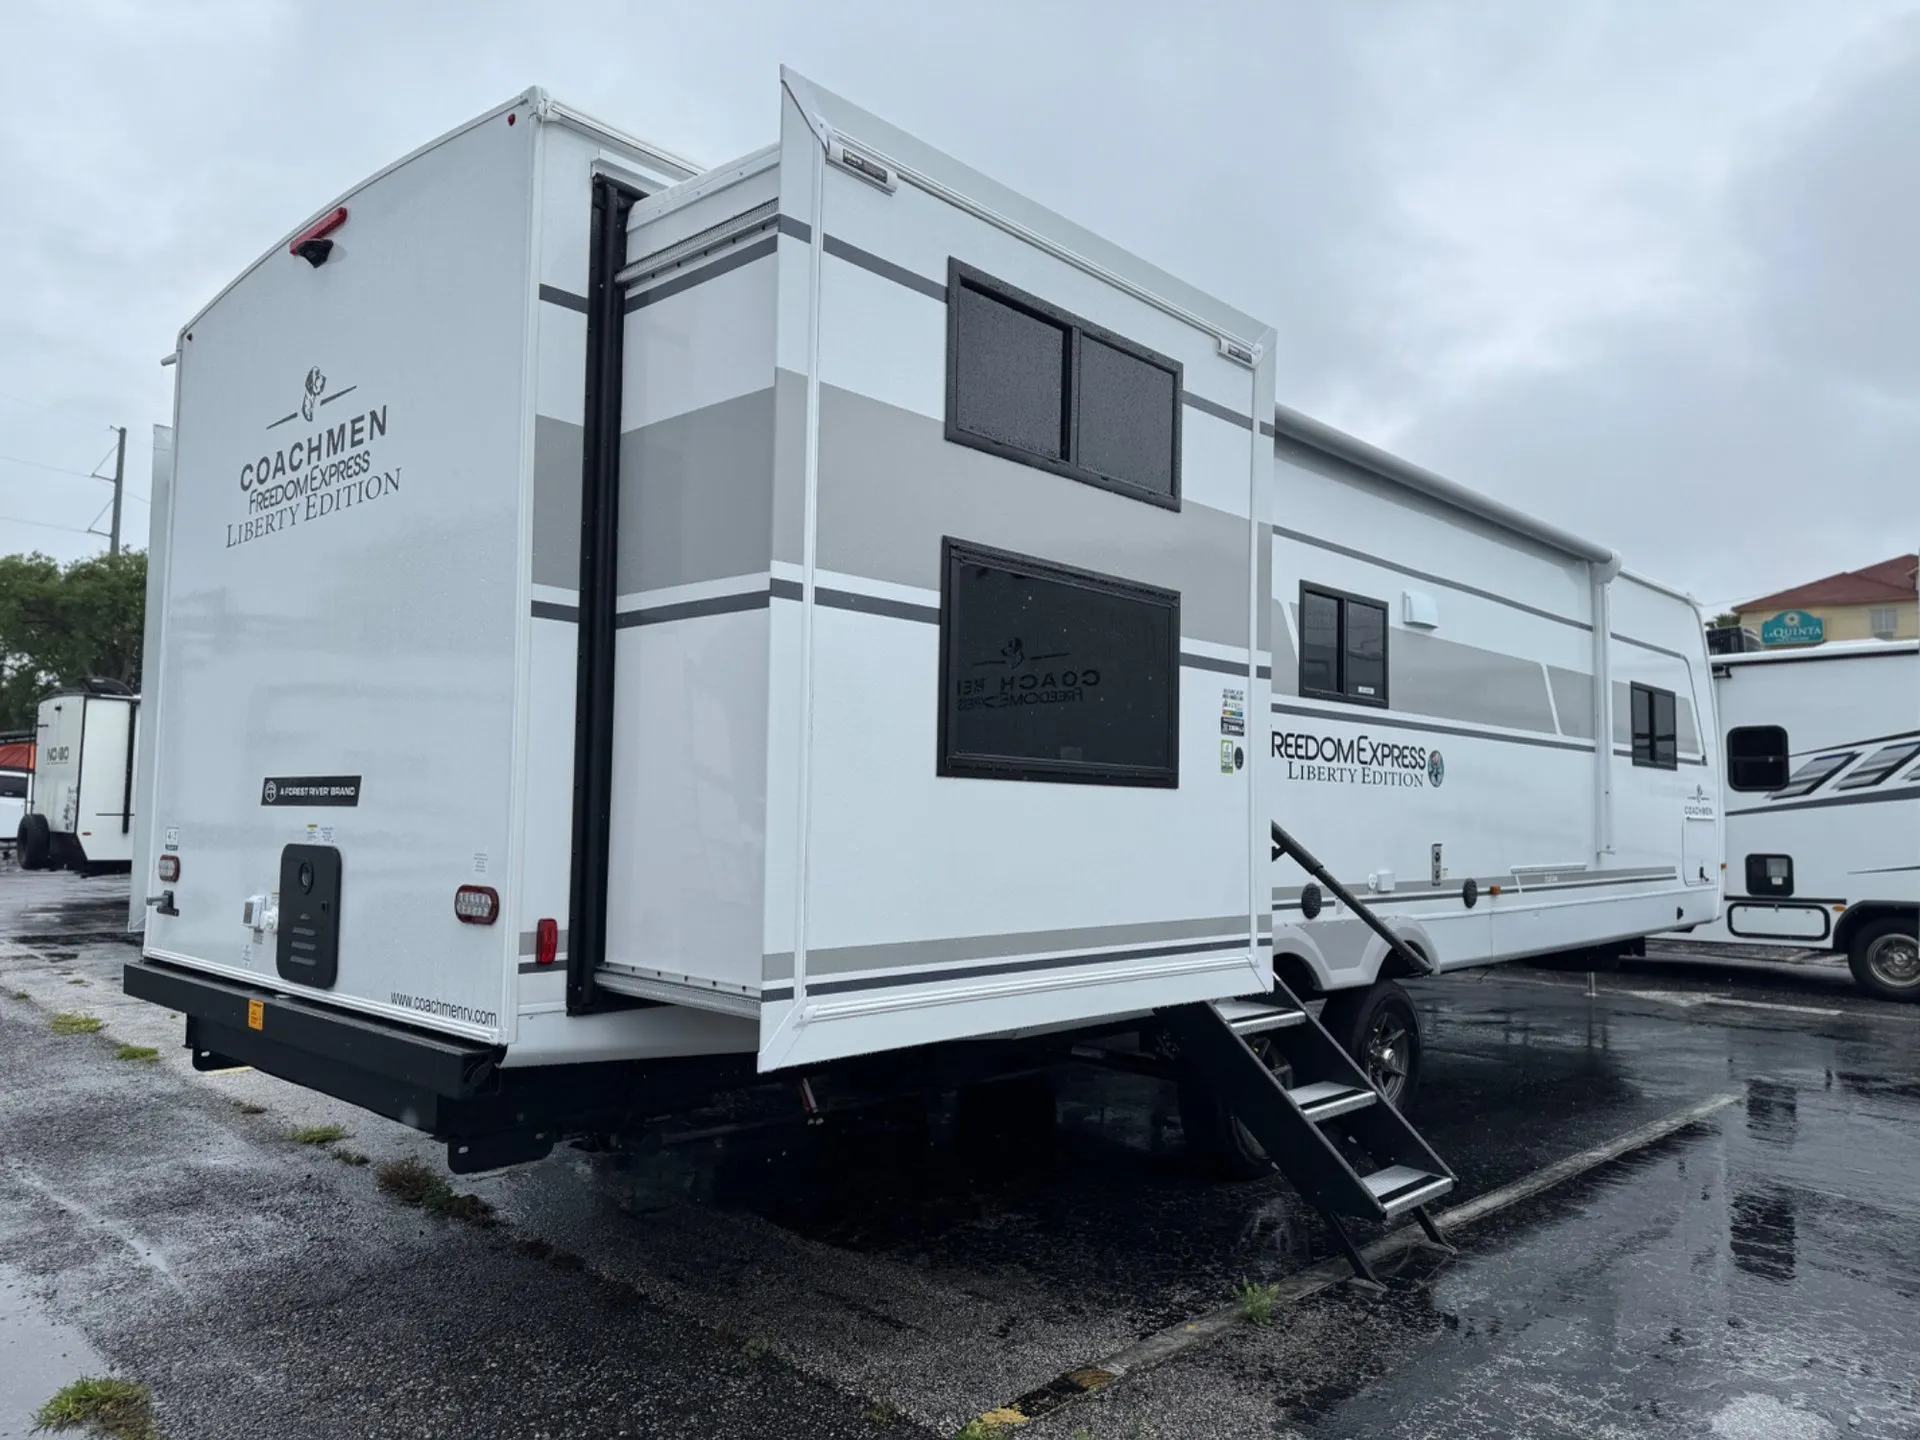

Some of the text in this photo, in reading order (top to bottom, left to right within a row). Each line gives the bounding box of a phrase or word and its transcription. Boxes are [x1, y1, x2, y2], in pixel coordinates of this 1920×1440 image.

[240, 405, 387, 491] COACHMEN
[226, 468, 402, 548] LIBERTY EDITION
[1773, 626, 1821, 638] QUINTA
[1271, 731, 1426, 770] REEDOMEXPRESS
[285, 786, 308, 796] FOREST
[330, 786, 356, 796] BRAND
[1287, 761, 1424, 788] LIBERTY EDITION
[391, 992, 497, 1026] www.coachmenrv.com
